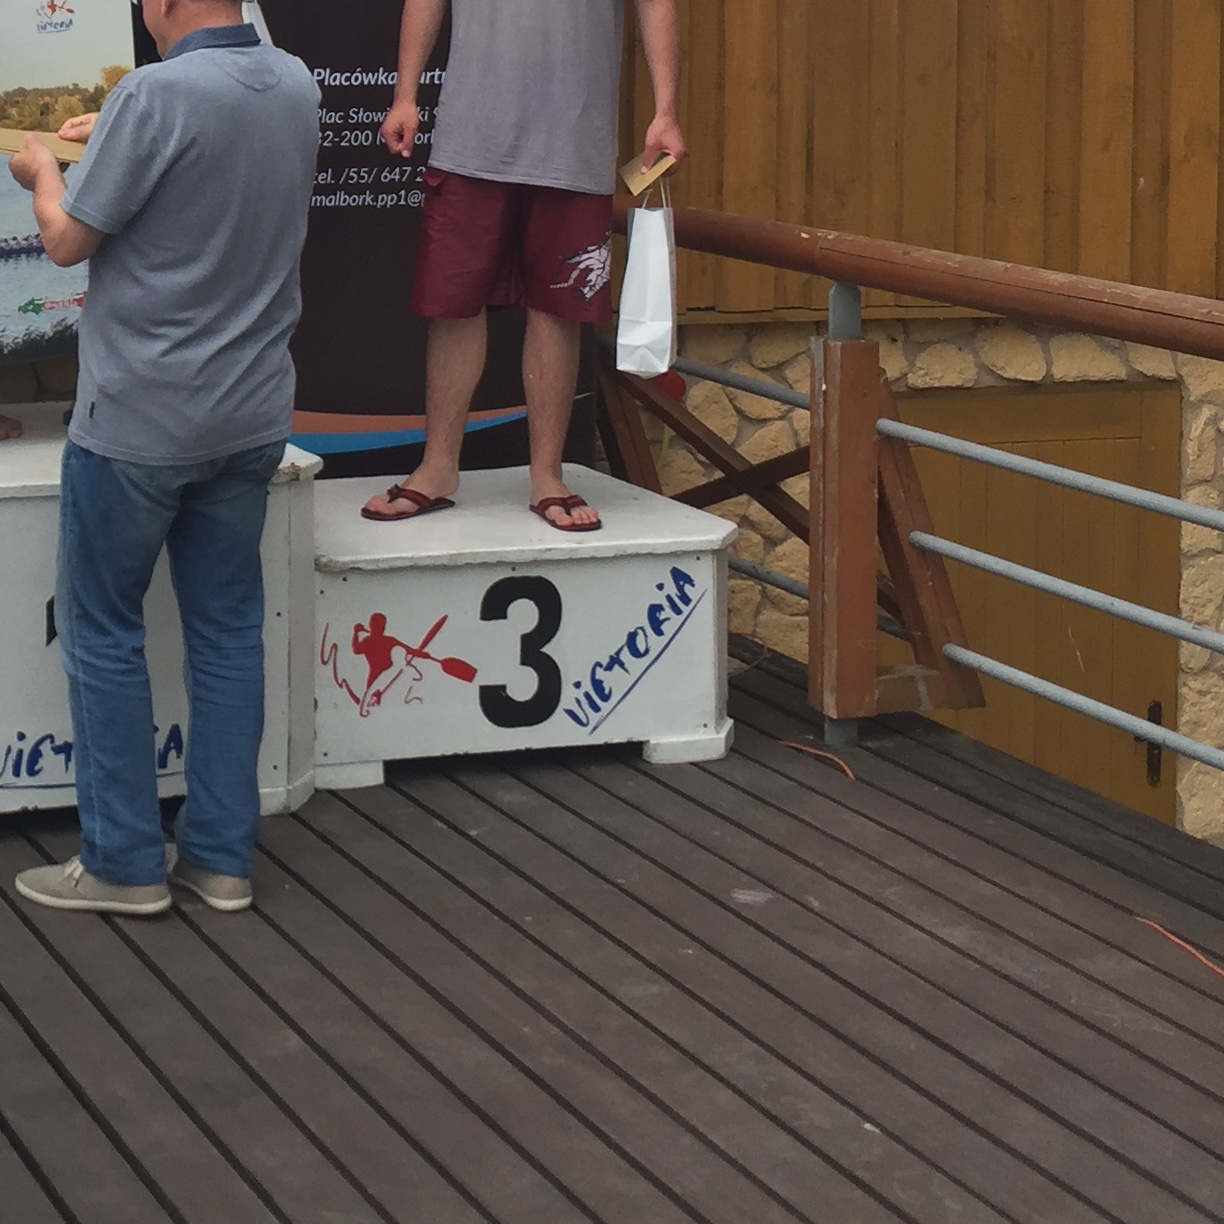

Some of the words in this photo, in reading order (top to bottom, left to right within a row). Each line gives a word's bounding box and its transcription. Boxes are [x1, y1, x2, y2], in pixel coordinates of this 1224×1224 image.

[313, 66, 397, 86] Placówka
[339, 166, 376, 184] /55/
[380, 166, 412, 182] 647
[479, 575, 562, 728] 3
